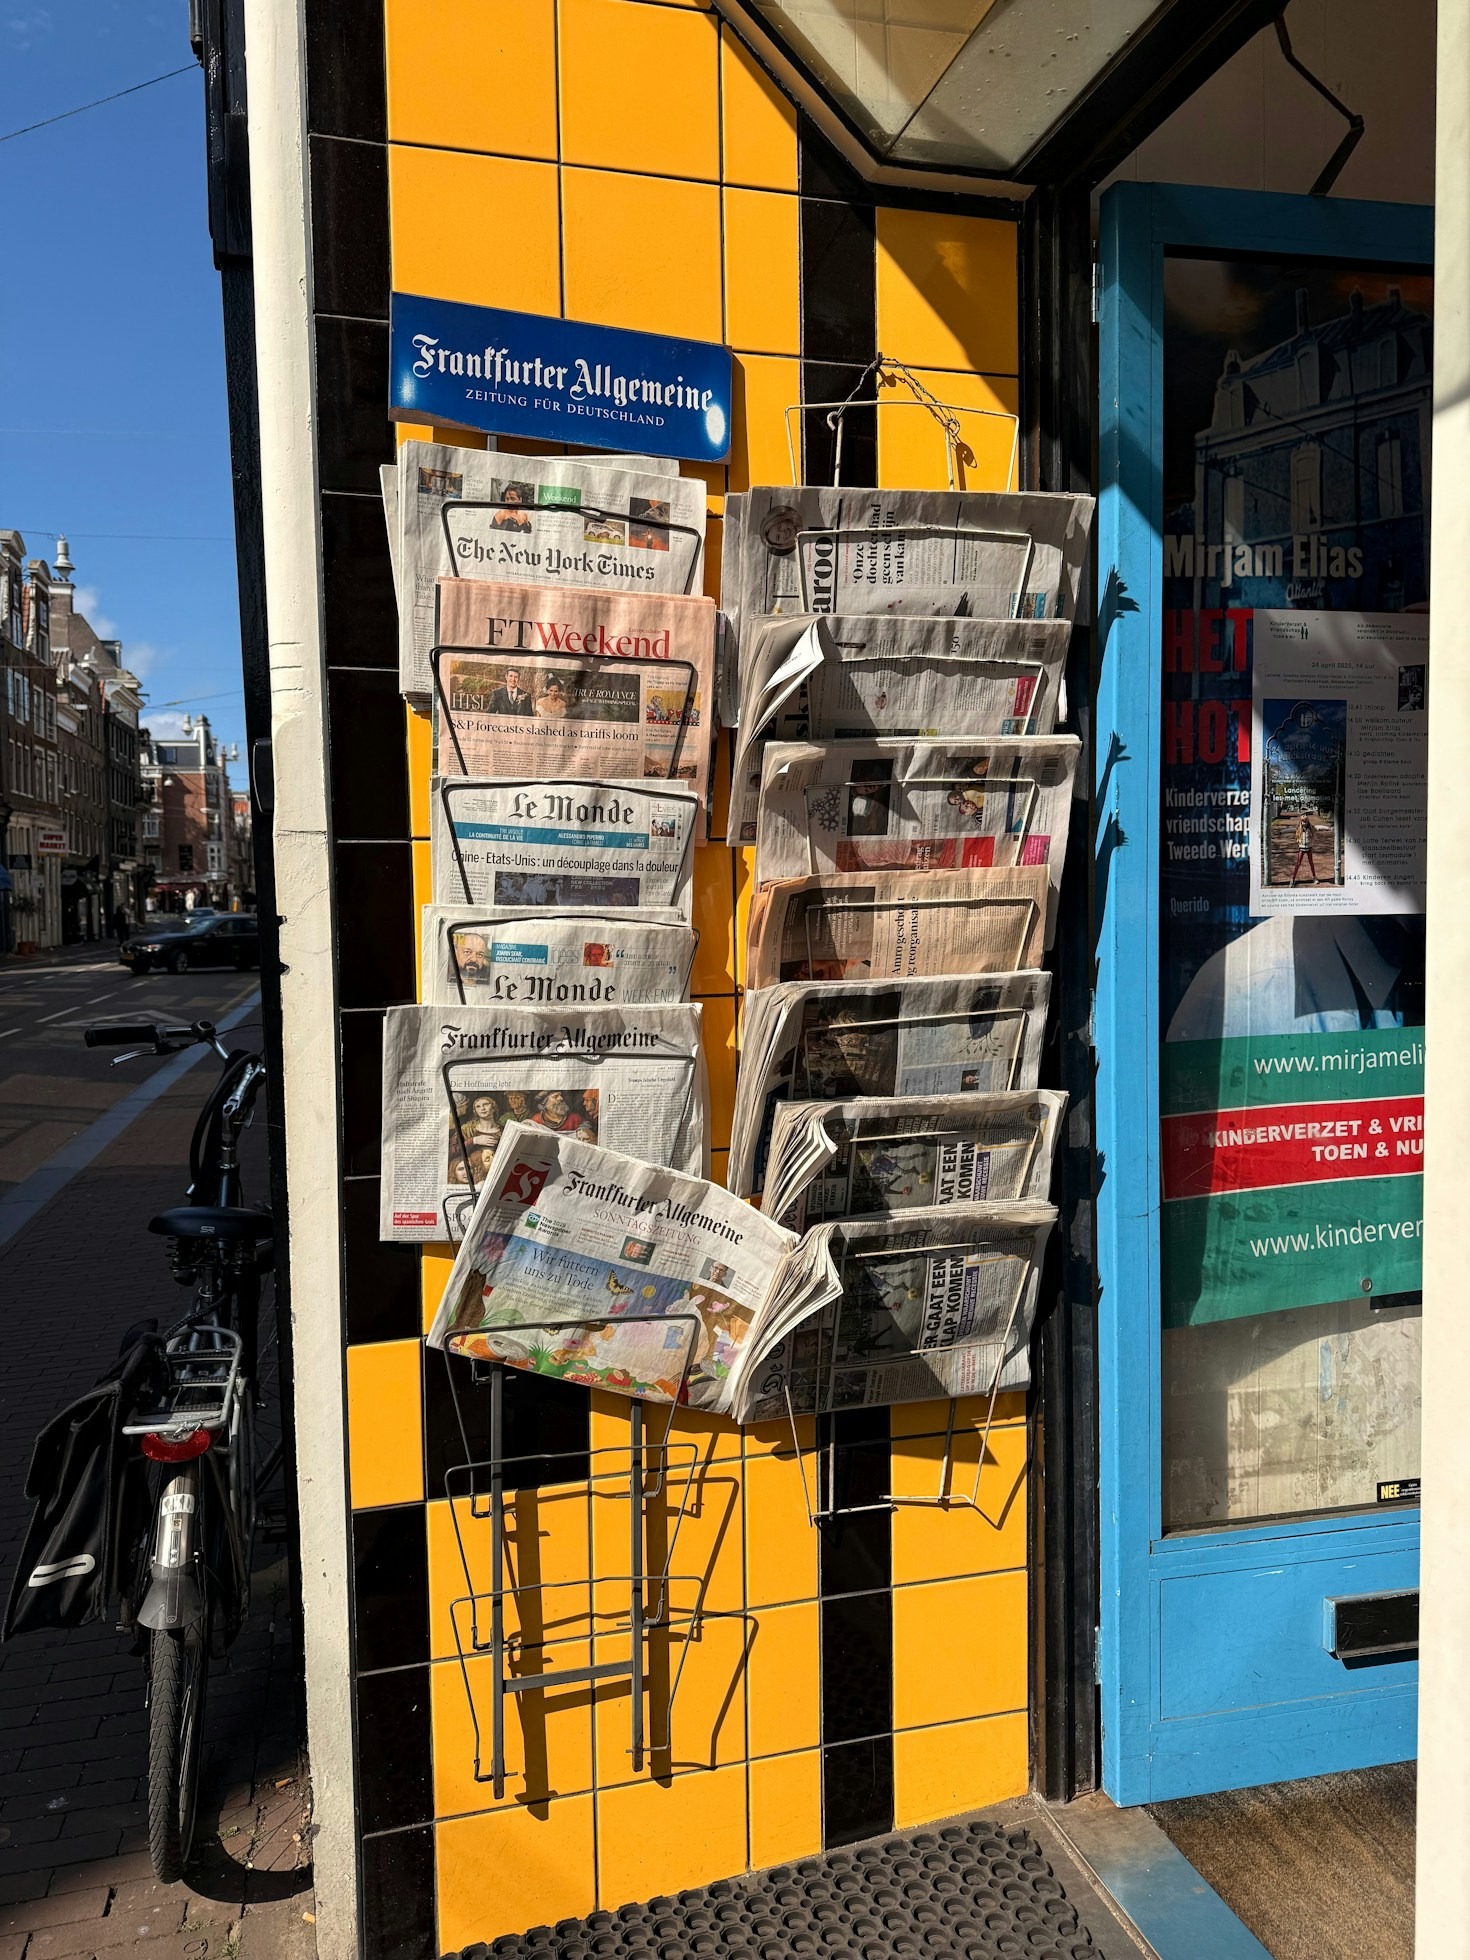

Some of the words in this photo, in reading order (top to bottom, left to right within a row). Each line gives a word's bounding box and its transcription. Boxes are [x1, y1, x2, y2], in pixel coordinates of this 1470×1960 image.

[412, 334, 568, 390] Frankfurter
[569, 358, 713, 412] Allgemeine
[465, 389, 527, 407] ZEITUNG
[534, 398, 561, 412] FÜR
[567, 403, 665, 427] DEUTSCHLAND
[543, 491, 577, 504] Weekend
[456, 536, 495, 564] The
[498, 542, 541, 566] New
[546, 548, 594, 575] York
[597, 553, 655, 580] Times
[881, 554, 893, 584] geen
[894, 560, 905, 584] van
[1163, 534, 1282, 588] Mirjam
[1293, 534, 1364, 578] Elias
[486, 617, 532, 648] FT
[534, 622, 670, 658] Weekend
[1166, 608, 1254, 672] HET
[1320, 662, 1336, 670] april
[452, 692, 485, 711] HTSI
[574, 687, 594, 698] TRUE
[596, 689, 637, 700] ROMANCE
[450, 719, 474, 732] S&P
[476, 720, 524, 735] forecasts
[526, 723, 566, 738] slashed
[567, 729, 578, 738] as
[580, 727, 611, 740] tariffs
[612, 730, 639, 742] loom
[508, 792, 538, 820] Le
[540, 793, 634, 825] Monde
[1166, 788, 1252, 808] Kinderverze
[543, 860, 555, 868] un
[556, 856, 611, 872] découplage
[612, 858, 634, 870] dans
[636, 860, 646, 871] la
[646, 860, 678, 872] douleur
[1168, 841, 1216, 860] Tweede
[1170, 898, 1210, 916] Querido
[551, 946, 580, 964] idées
[892, 946, 903, 974] Amro
[488, 974, 518, 1000] Le
[522, 974, 616, 1002] Monde
[622, 988, 675, 1003] WEEK-END
[441, 1024, 554, 1054] Frankfurter
[556, 1026, 660, 1054] Allgemeine
[1254, 1044, 1425, 1074] www.mirjameli
[396, 1080, 426, 1088] Haftstrafe
[450, 1080, 461, 1088] Die
[464, 1080, 498, 1088] Hoffnung
[498, 1080, 511, 1088] lebt
[407, 1095, 430, 1103] Shapira
[1209, 1120, 1362, 1148] KINDERVERZET
[1368, 1118, 1382, 1135] &
[942, 1143, 958, 1172] EEN
[1312, 1142, 1368, 1162] TOEN
[1374, 1142, 1389, 1158] &
[1396, 1138, 1424, 1156] NU
[562, 1170, 656, 1215] Frankfurter
[655, 1198, 744, 1246] Allgemeine
[592, 1208, 702, 1245] SONNTAGSZEITUNG
[533, 1248, 557, 1265] Wir
[524, 1266, 546, 1279] uns
[547, 1273, 561, 1284] zu
[566, 1272, 594, 1290] Tode
[931, 1258, 946, 1288] EEN
[969, 1270, 978, 1298] RECESSIE
[960, 1274, 972, 1316] WAARSCHUWT
[926, 1293, 942, 1331] GAAT
[940, 1317, 959, 1352] KLAP
[1380, 1484, 1400, 1500] NEE
